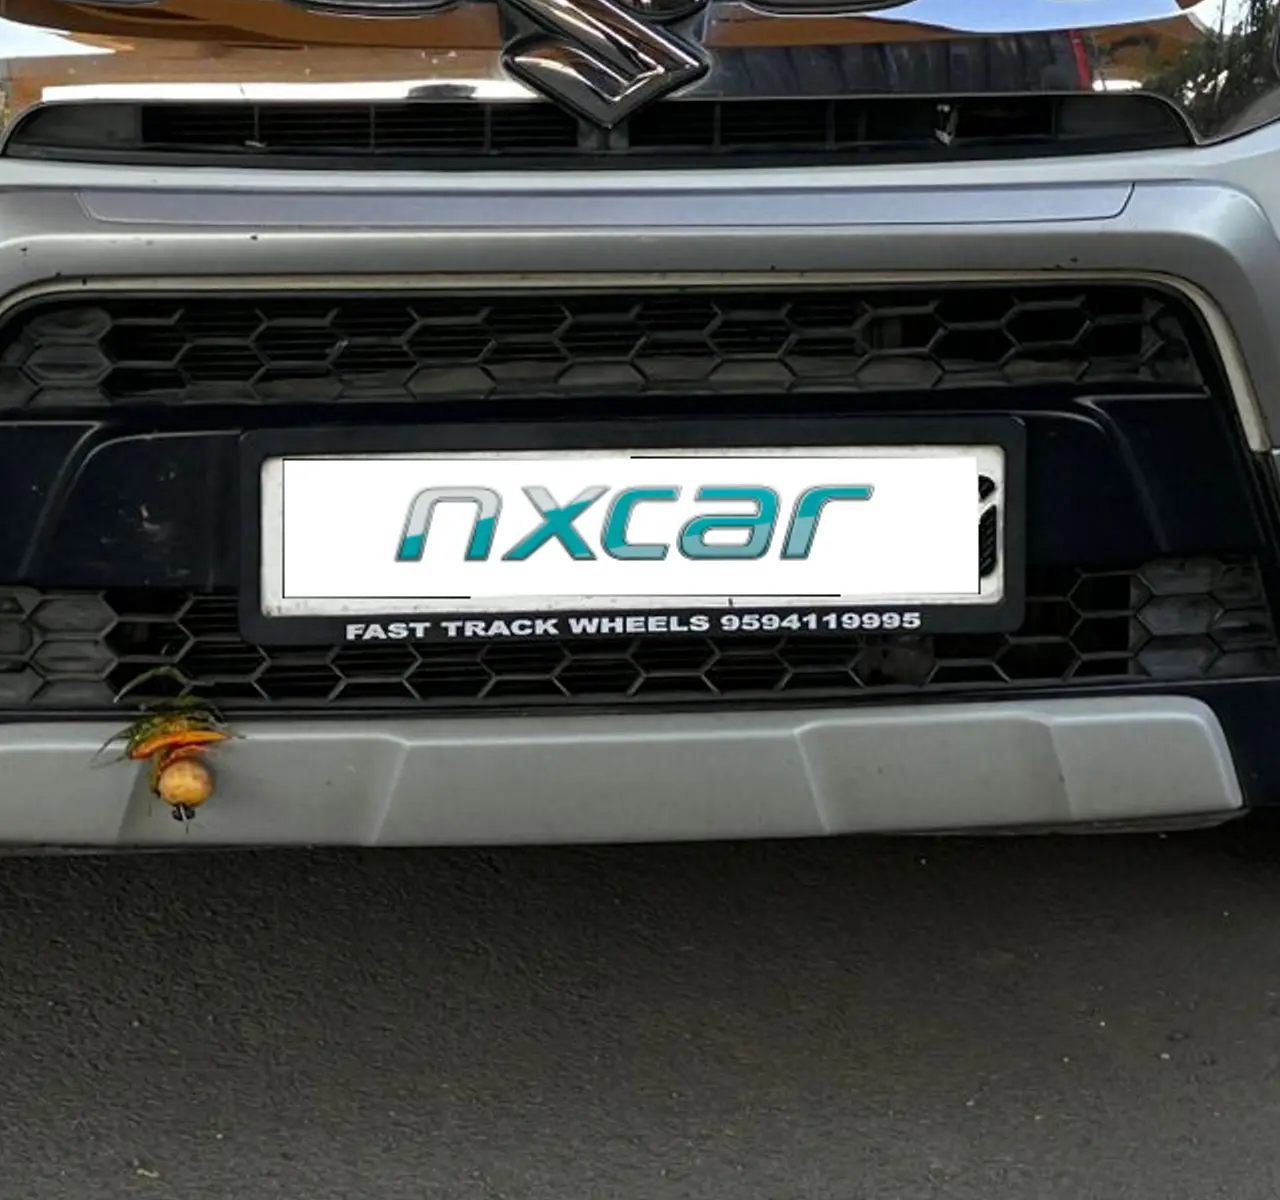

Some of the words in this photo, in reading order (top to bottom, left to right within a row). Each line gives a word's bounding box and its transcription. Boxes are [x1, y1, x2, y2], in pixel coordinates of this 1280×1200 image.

[345, 621, 431, 640] FAST
[440, 618, 559, 637] TRACK
[568, 615, 710, 633] WHEELS
[720, 612, 921, 631] 9594119995
